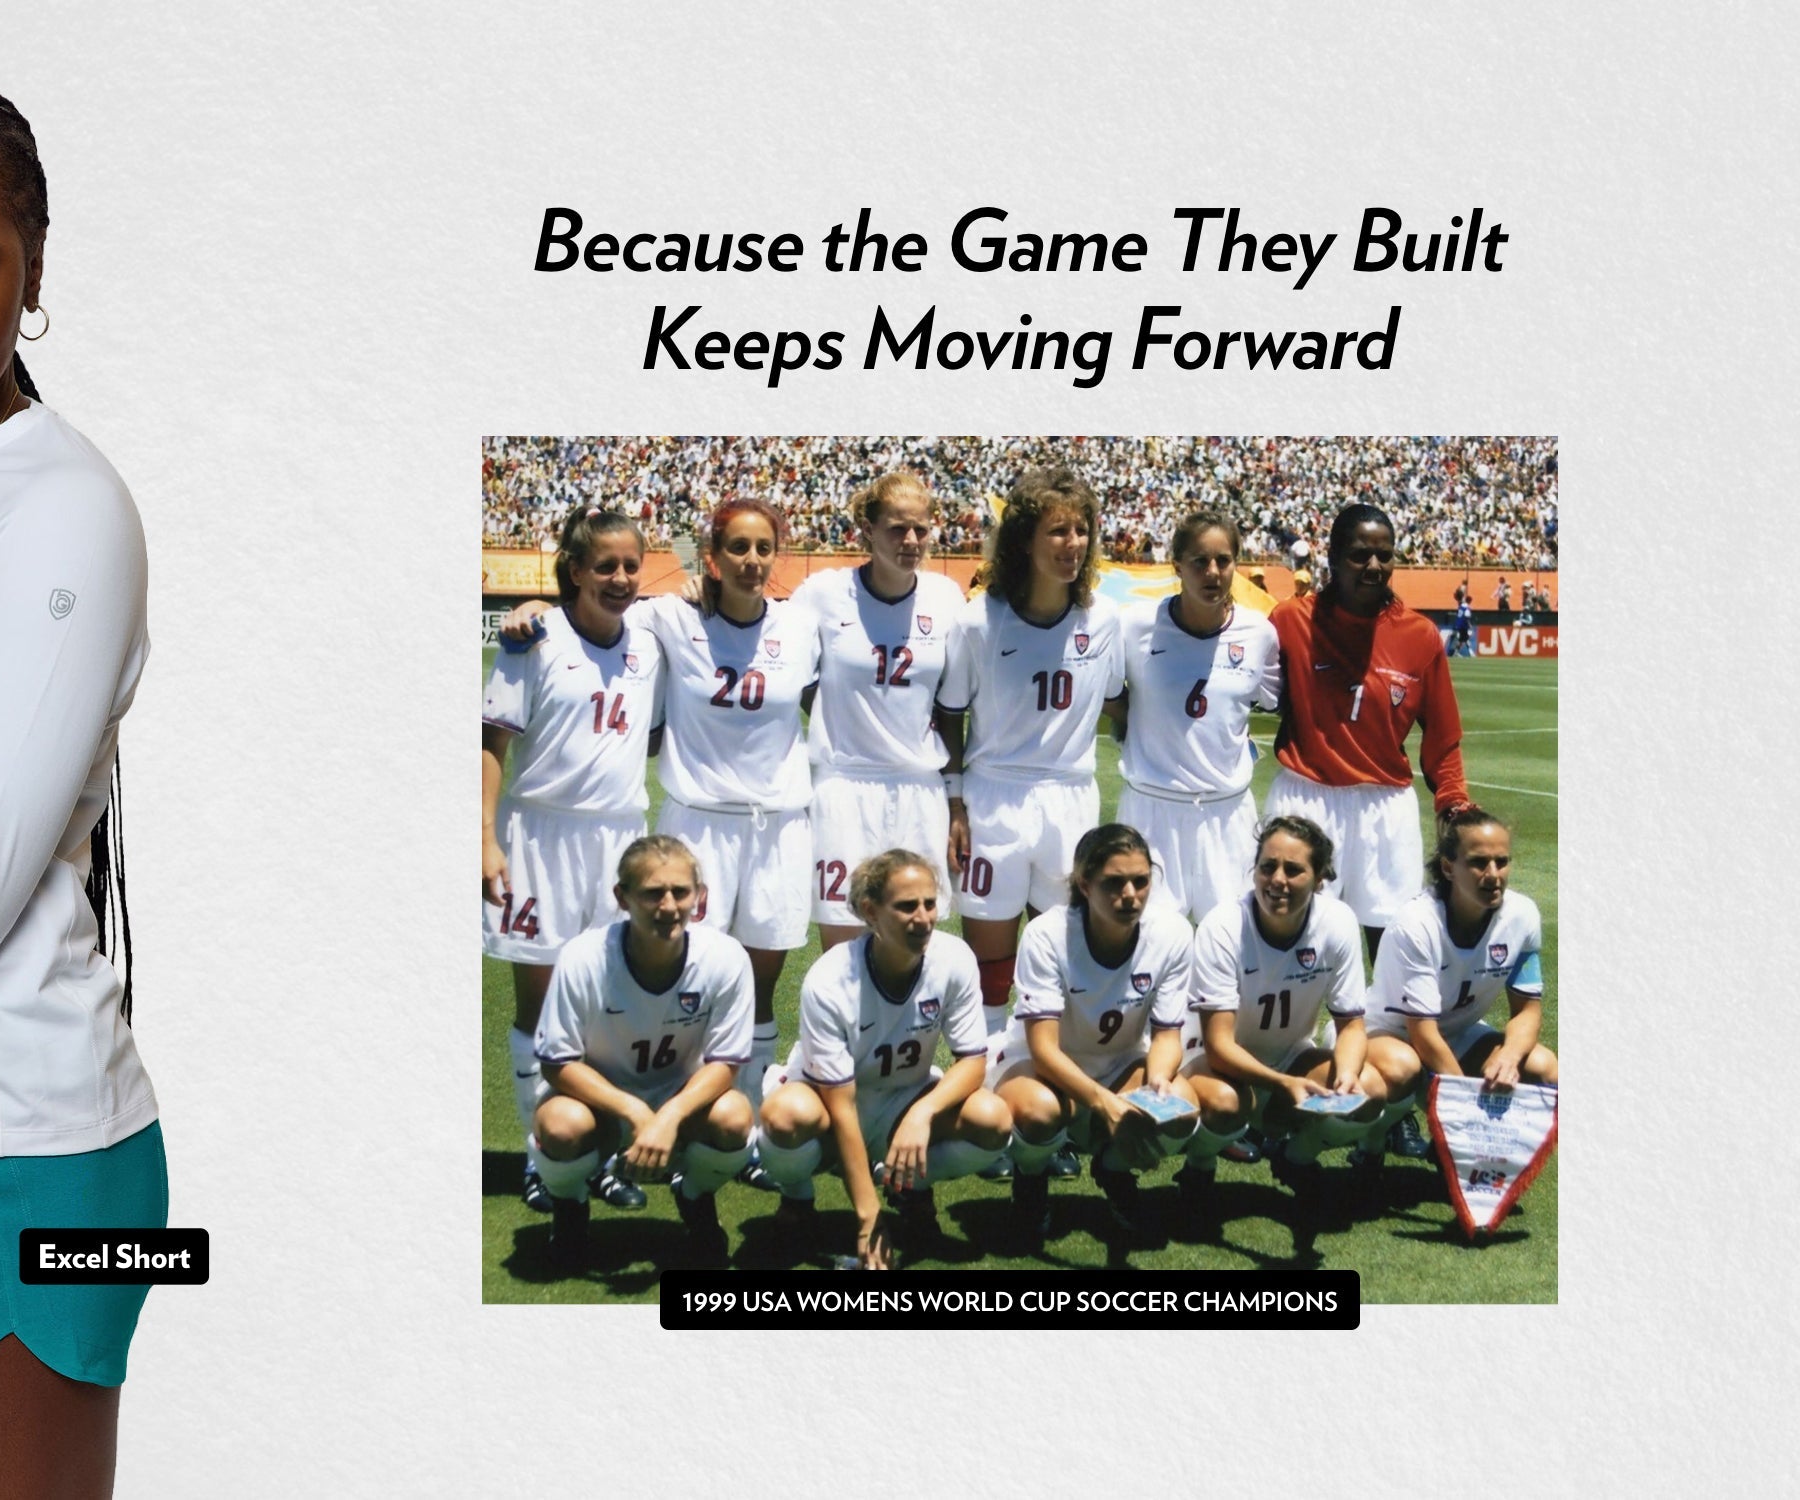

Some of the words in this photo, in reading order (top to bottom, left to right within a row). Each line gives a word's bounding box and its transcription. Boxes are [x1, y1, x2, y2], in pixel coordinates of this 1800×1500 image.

[1478, 627, 1538, 656] JVC
[872, 644, 913, 687] 12
[710, 666, 766, 711] 20
[1032, 670, 1073, 711] 10
[1185, 679, 1208, 718] 6
[1350, 684, 1364, 721] 1
[590, 691, 628, 735] 14
[816, 859, 847, 901] 12
[961, 857, 993, 897] 10
[500, 892, 540, 939] 14
[1098, 1010, 1123, 1045] 9
[1257, 989, 1291, 1030] 11
[631, 1034, 676, 1073] 16
[874, 1039, 921, 1077] 13
